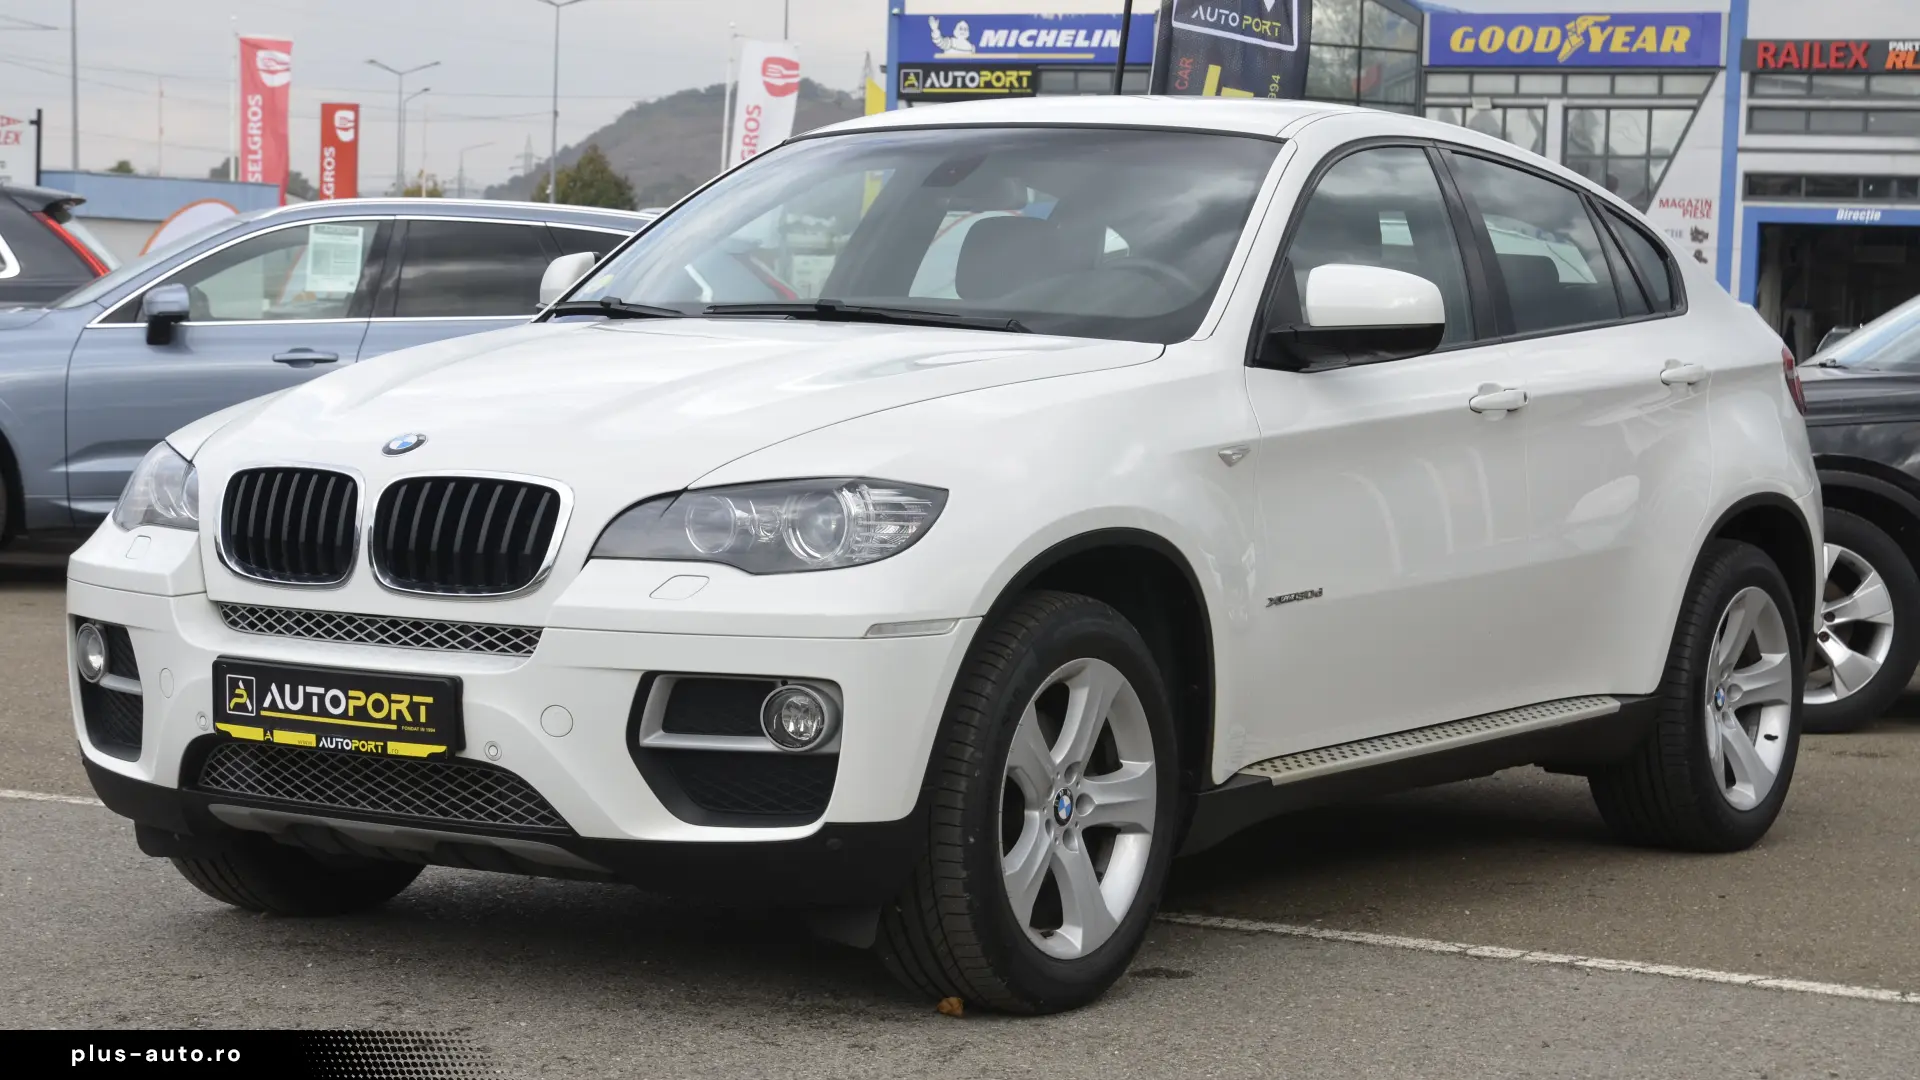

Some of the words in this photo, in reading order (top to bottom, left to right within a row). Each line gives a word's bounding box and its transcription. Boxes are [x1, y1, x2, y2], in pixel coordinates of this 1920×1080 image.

[979, 29, 1121, 48] MICHELIN
[1756, 41, 1870, 69] RAILEX
[925, 71, 1032, 88] AUTOPORT
[1175, 57, 1194, 90] CAR
[247, 94, 263, 183] SELGROS
[1659, 198, 1712, 209] MAGAZIN
[1682, 206, 1712, 219] PIESE
[262, 682, 434, 723] AUTOPORT
[319, 736, 384, 753] AUTOPORT
